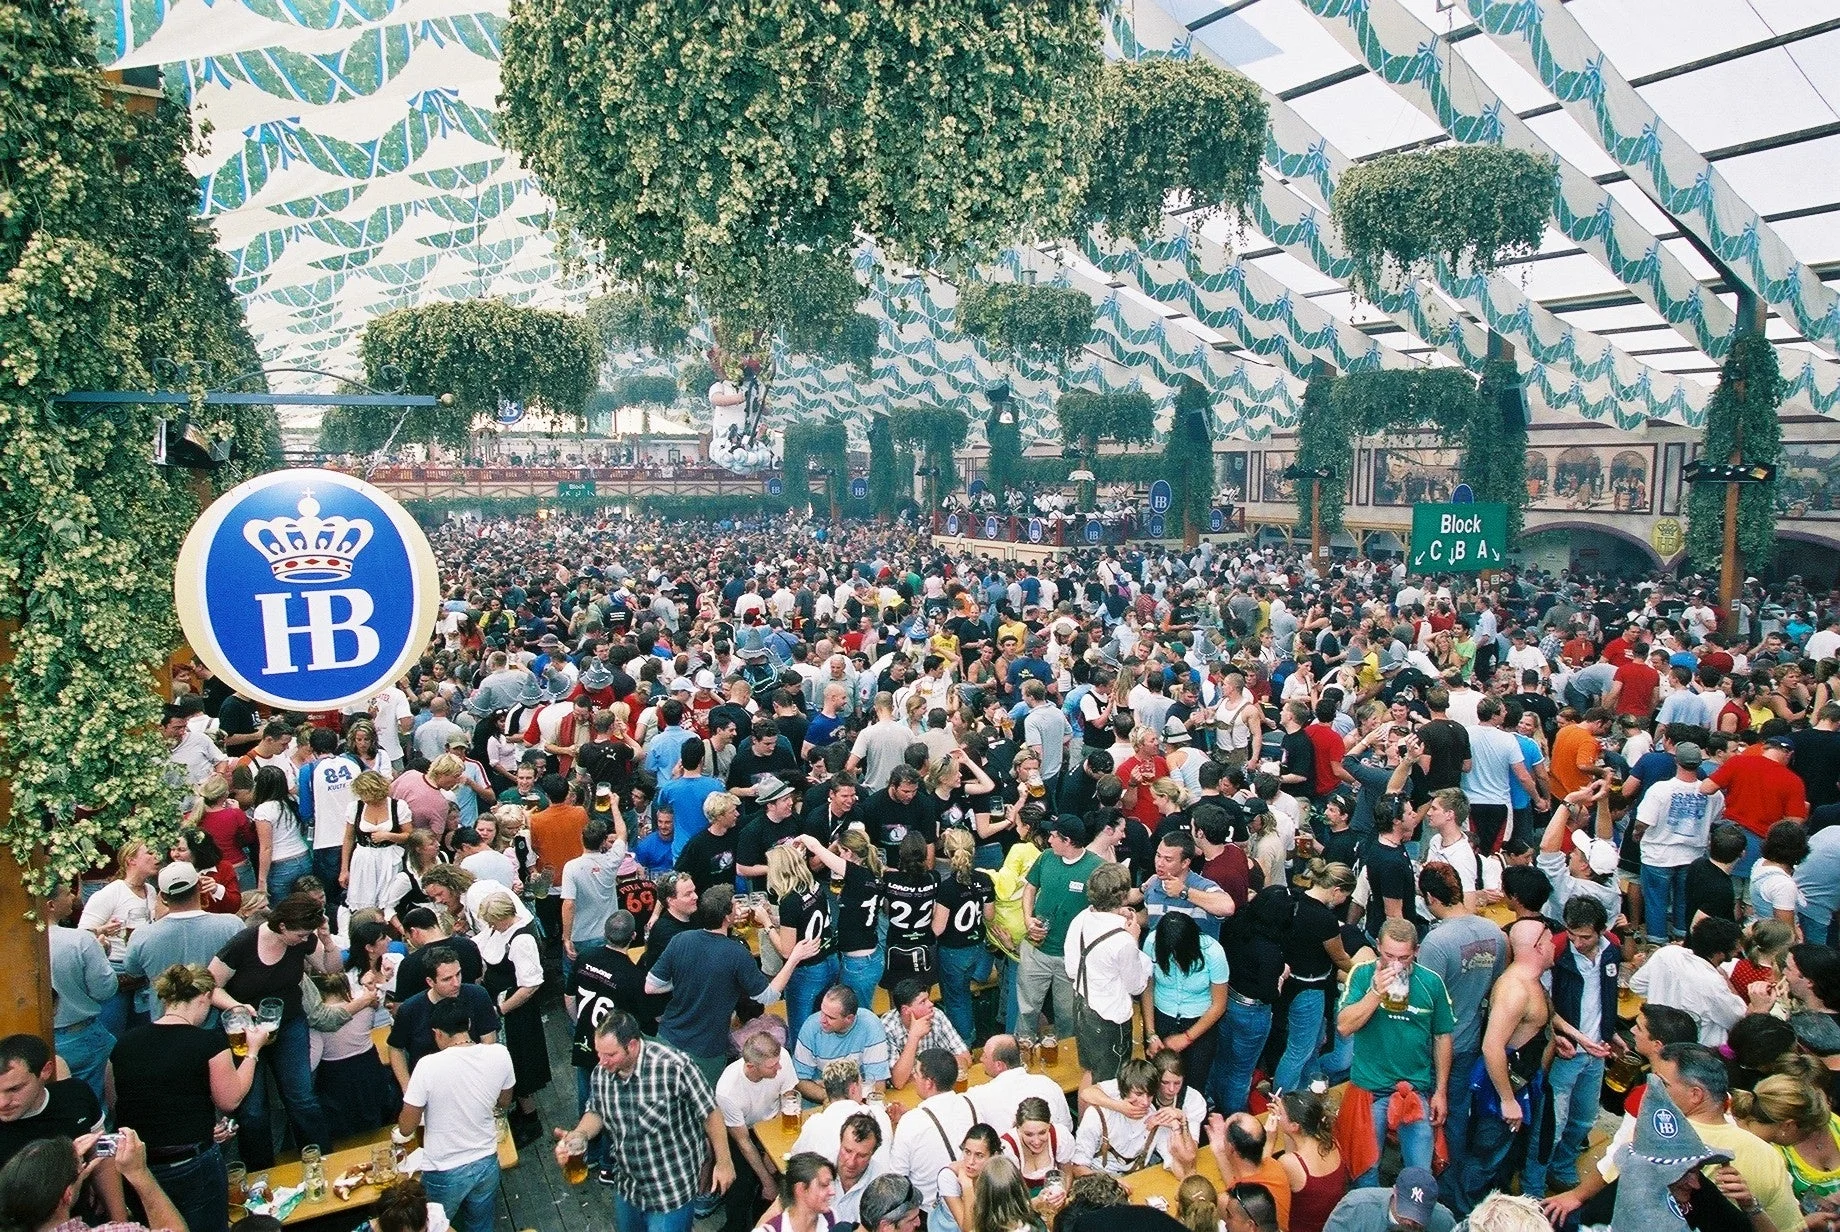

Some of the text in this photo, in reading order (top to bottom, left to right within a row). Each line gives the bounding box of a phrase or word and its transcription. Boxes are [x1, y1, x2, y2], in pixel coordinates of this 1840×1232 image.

[854, 487, 865, 496] HB
[1154, 496, 1167, 509] HB
[1211, 519, 1220, 528] HB
[1440, 513, 1482, 534] Block
[1430, 539, 1488, 560] C B A
[254, 588, 380, 675] HB
[324, 765, 353, 784] 84
[619, 883, 642, 895] PUTA
[888, 882, 916, 893] LORDY
[626, 890, 655, 913] 69
[889, 899, 933, 930] 22
[576, 985, 615, 1028] 76
[1658, 1122, 1675, 1134] HB
[1410, 1186, 1424, 1203] NY
